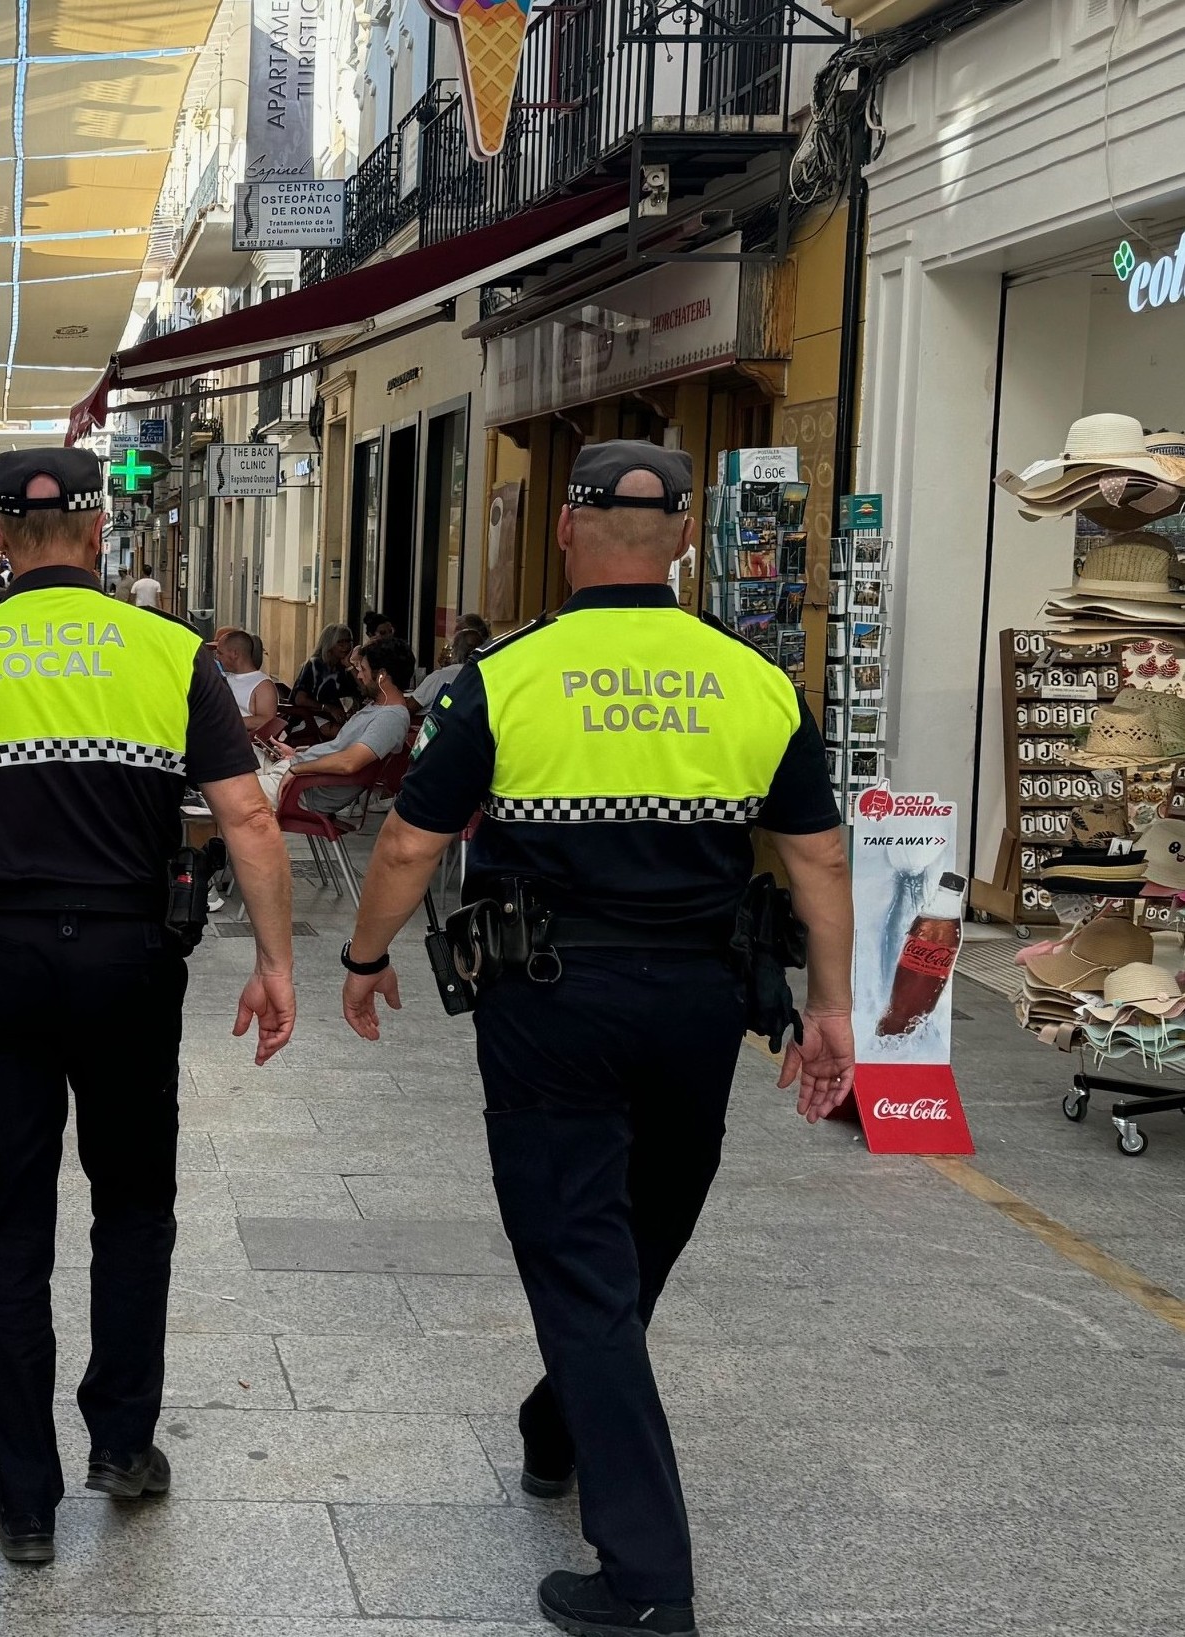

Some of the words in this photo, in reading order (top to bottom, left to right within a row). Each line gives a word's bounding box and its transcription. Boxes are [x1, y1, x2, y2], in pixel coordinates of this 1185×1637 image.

[246, 154, 313, 182] Espinel
[278, 183, 325, 192] CENTRO
[261, 193, 342, 204] OSTEOPÁTICO
[271, 207, 287, 215] DE
[290, 206, 331, 215] RONDA
[1129, 231, 1185, 312] cot
[651, 298, 711, 335] HORCHATERIA
[233, 448, 249, 457] THE
[251, 448, 274, 457] BACK
[240, 461, 266, 470] CLINIC
[753, 465, 786, 480] 0.60€
[562, 667, 725, 700] POLICIA
[582, 703, 710, 734] LOCAL
[895, 795, 935, 806] COLD
[893, 805, 953, 817] DRINKS
[863, 837, 894, 846] TAKE
[895, 837, 933, 846] AWAY
[873, 1097, 949, 1120] Coca-Cola
